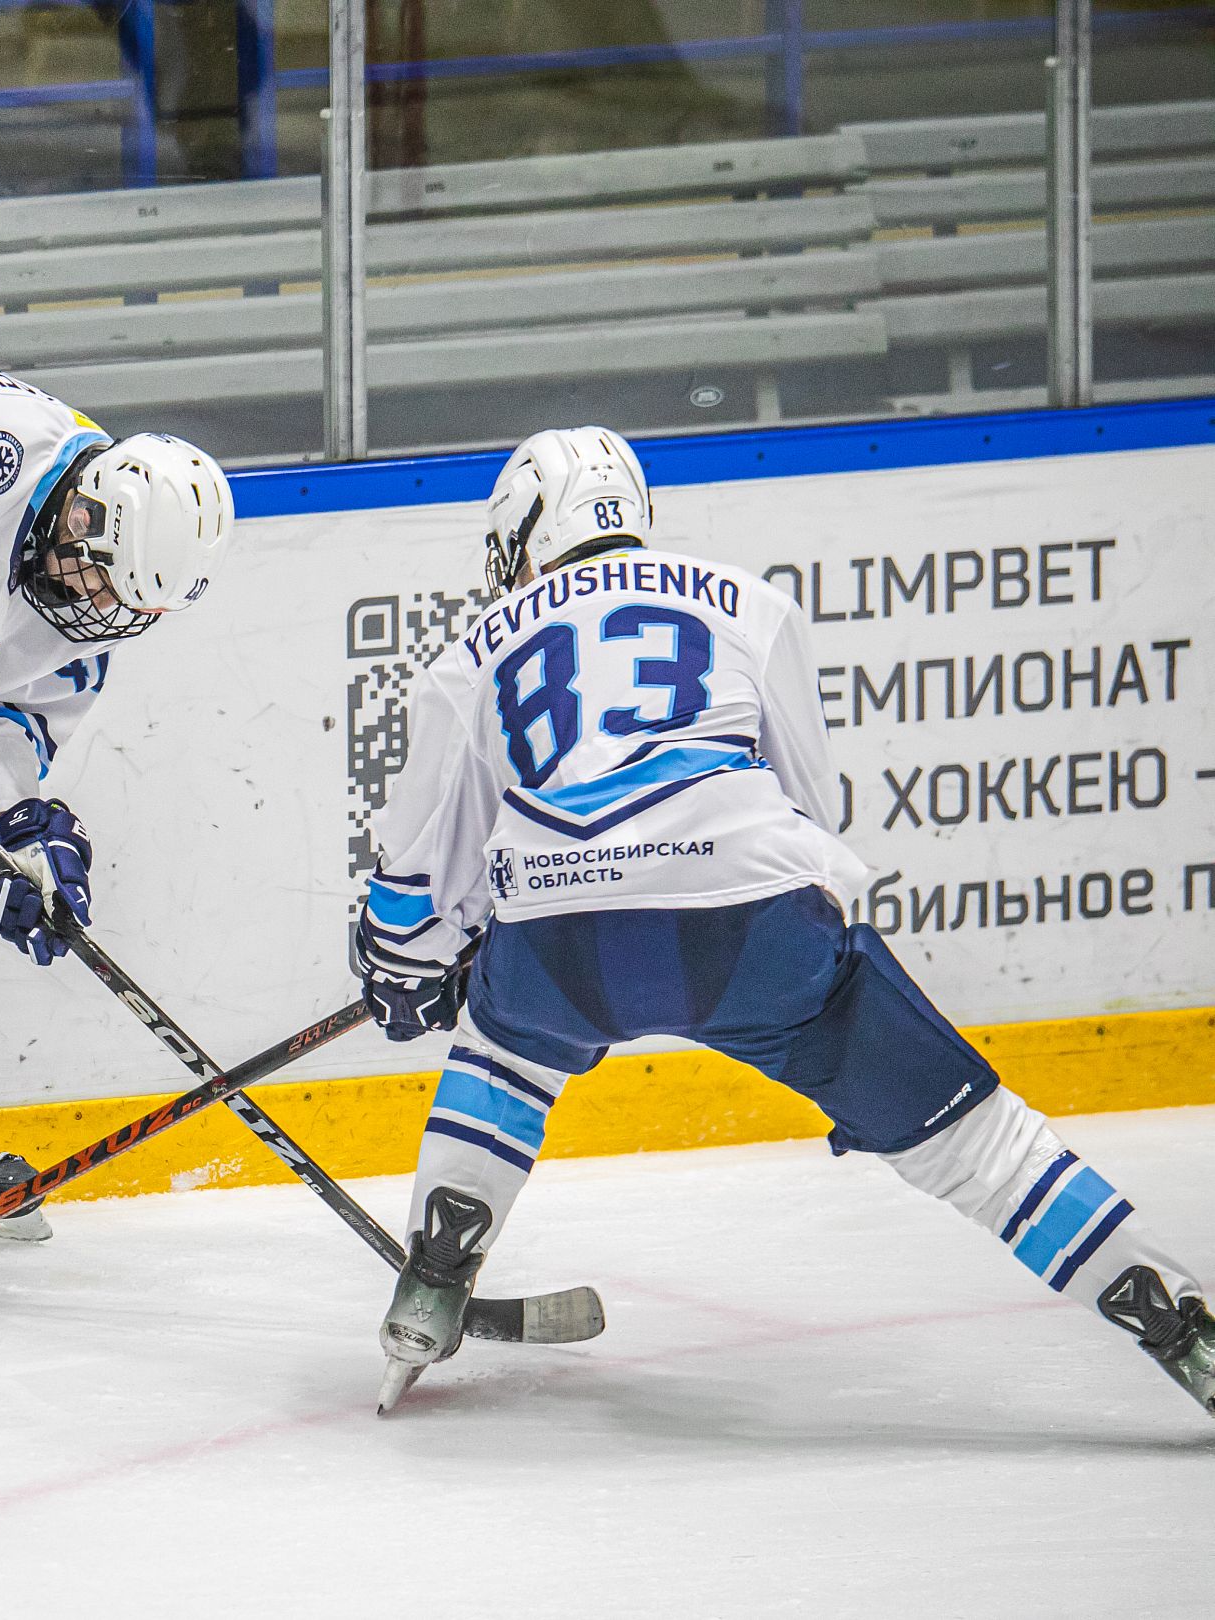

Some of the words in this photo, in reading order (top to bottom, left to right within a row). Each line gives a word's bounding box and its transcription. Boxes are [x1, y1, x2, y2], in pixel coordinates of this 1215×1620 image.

[112, 503, 123, 546] CCM
[593, 500, 624, 531] 83
[464, 562, 739, 669] YEVTUSHENKO
[493, 602, 715, 790] 83
[817, 638, 1192, 729] ЕМПИОНАТ
[882, 747, 1168, 832] ХОККЕЮ
[523, 840, 714, 870] НОВОСИБИРСКАЯ
[528, 867, 623, 890] ОБЛАСТЬ
[851, 868, 1154, 936] бильное
